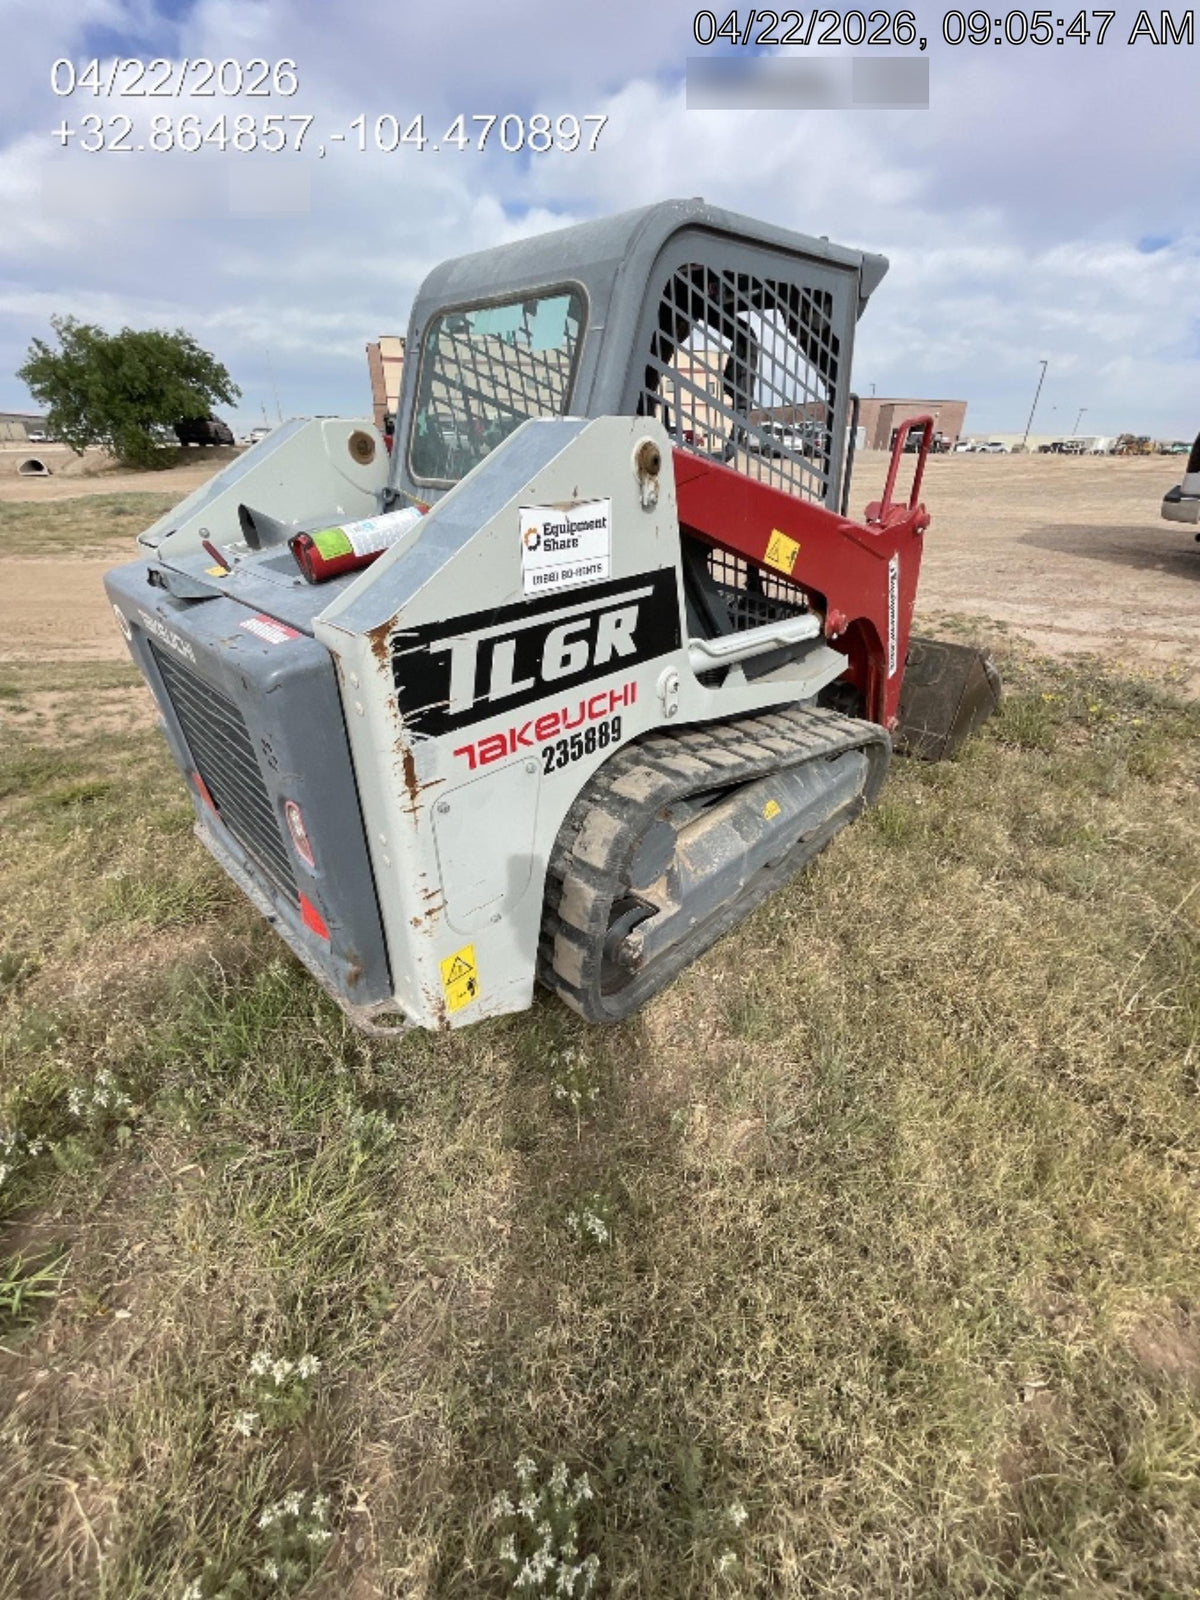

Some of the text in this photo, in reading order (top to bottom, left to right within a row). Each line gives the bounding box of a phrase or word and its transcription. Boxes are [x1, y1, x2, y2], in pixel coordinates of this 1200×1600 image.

[543, 516, 607, 537] Equipment
[543, 538, 579, 552] Share
[430, 604, 640, 714] TL6R
[542, 716, 622, 775] 235889
